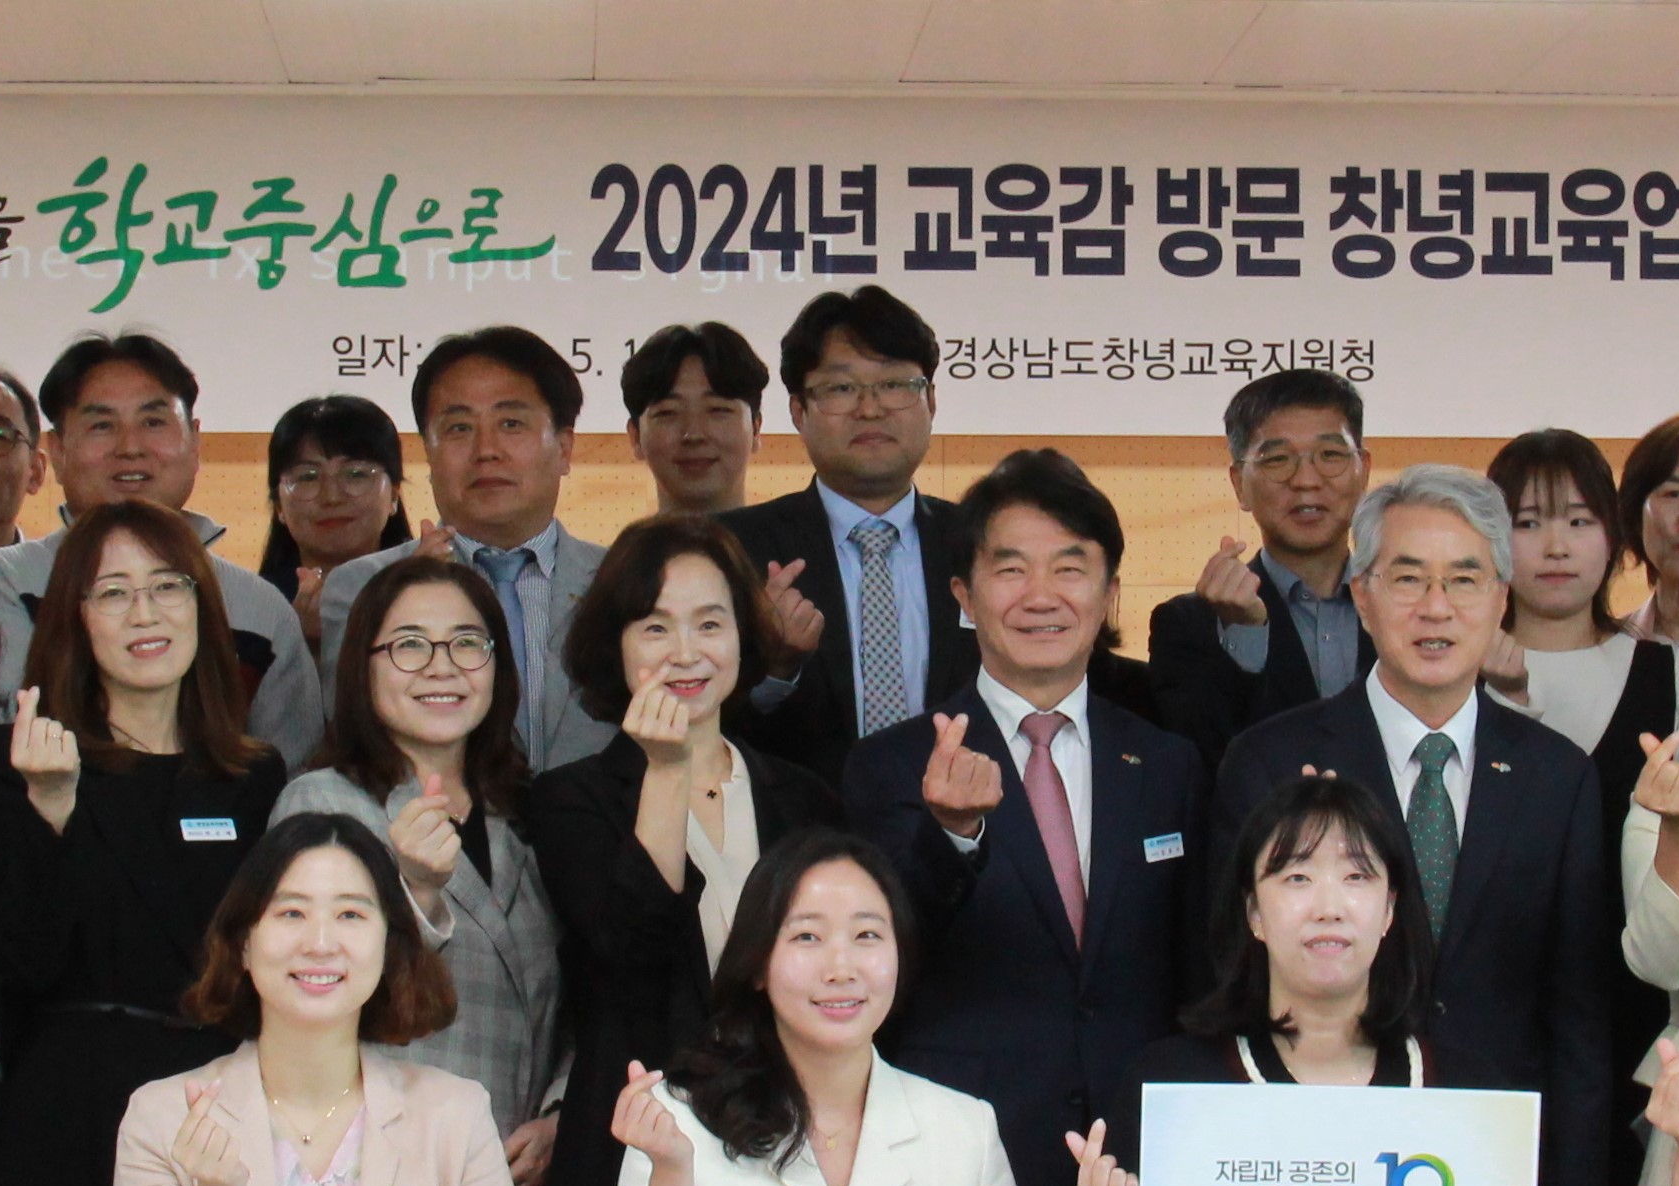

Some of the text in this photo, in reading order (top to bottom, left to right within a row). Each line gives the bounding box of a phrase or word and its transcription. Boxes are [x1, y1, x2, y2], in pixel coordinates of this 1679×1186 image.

[590, 162, 878, 275] 2024년
[903, 165, 1133, 277] 교육감
[1156, 165, 1305, 277] 방문
[942, 336, 1376, 383] 경상남도창녕교육지원청
[1214, 1160, 1356, 1184] 자립과 공존의
